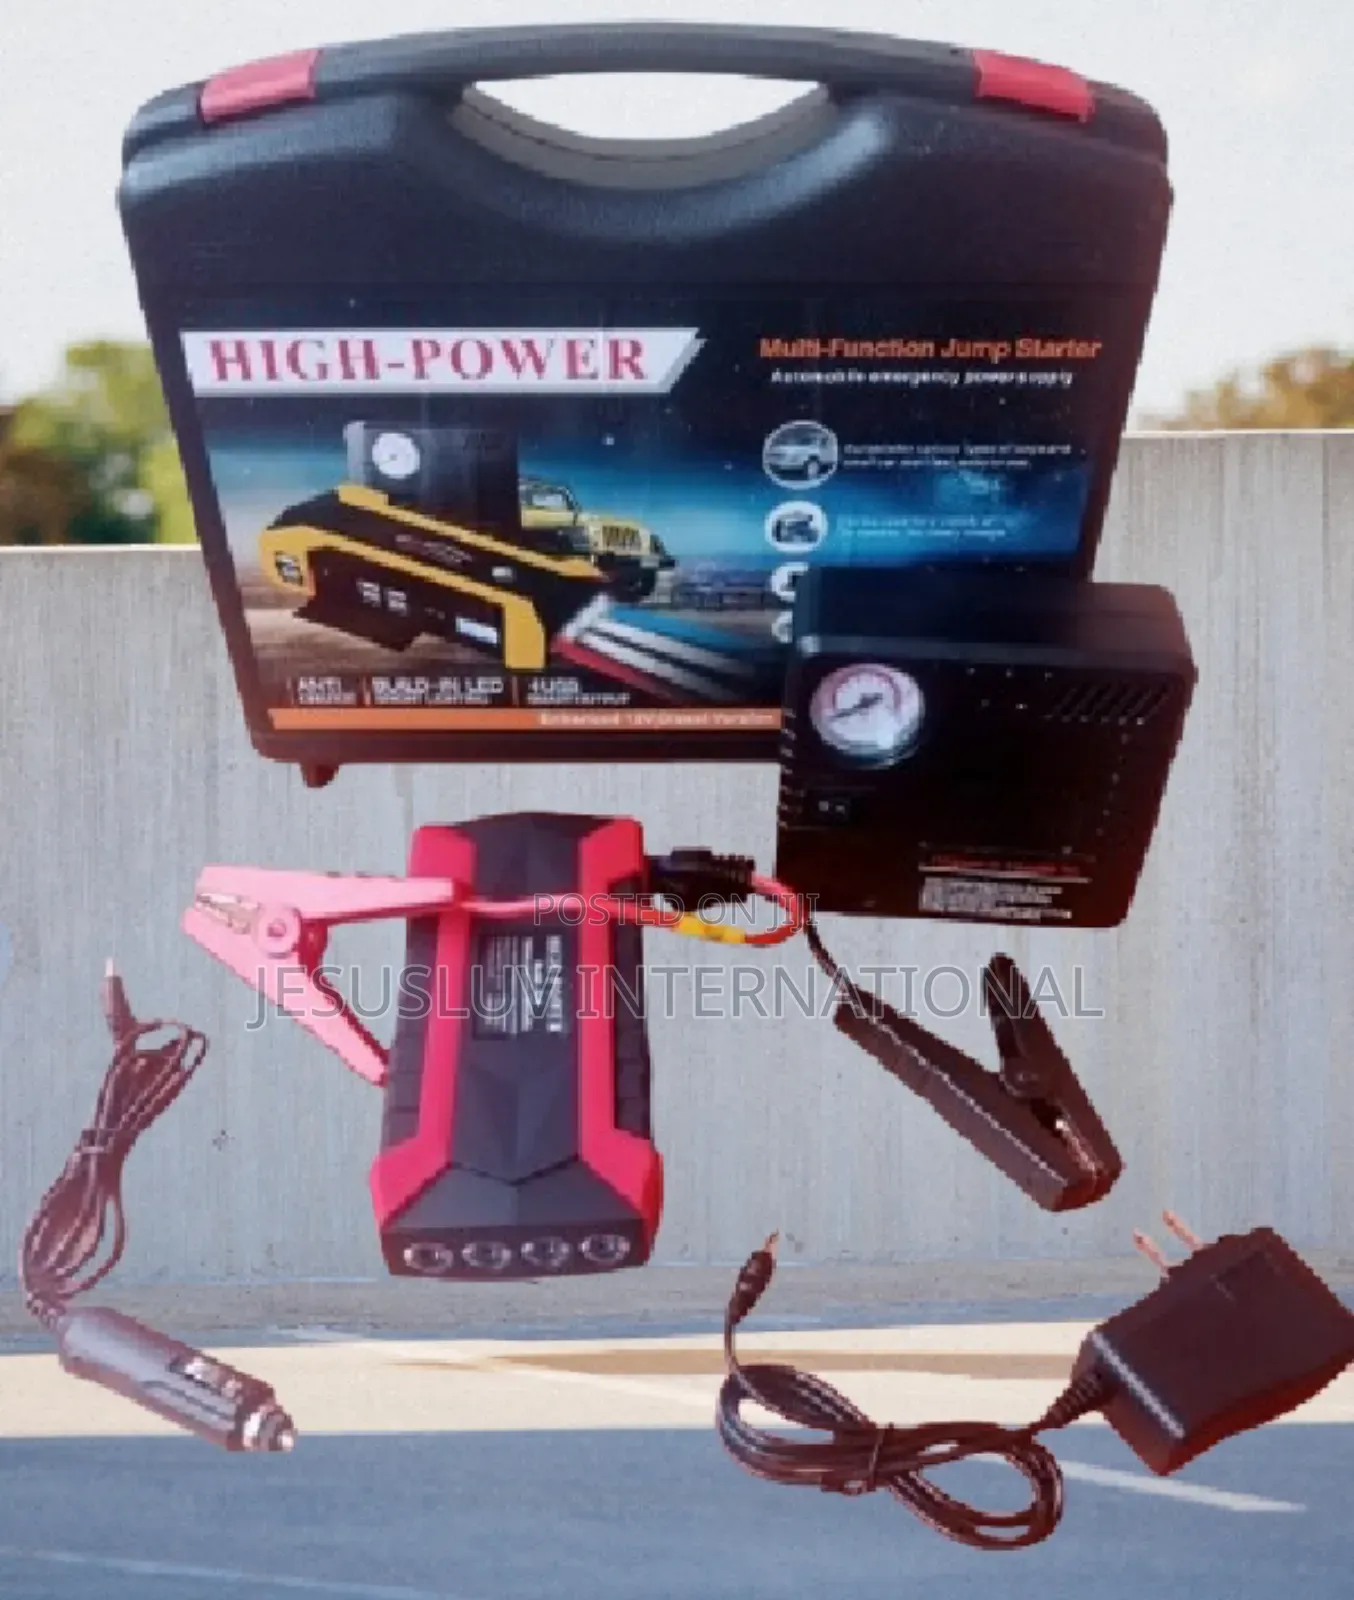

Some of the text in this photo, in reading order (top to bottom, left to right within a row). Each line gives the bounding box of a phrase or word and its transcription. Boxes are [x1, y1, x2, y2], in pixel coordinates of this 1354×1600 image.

[207, 337, 648, 382] HIGH-POWER
[759, 338, 1102, 365] Multi-Function Jump Starter
